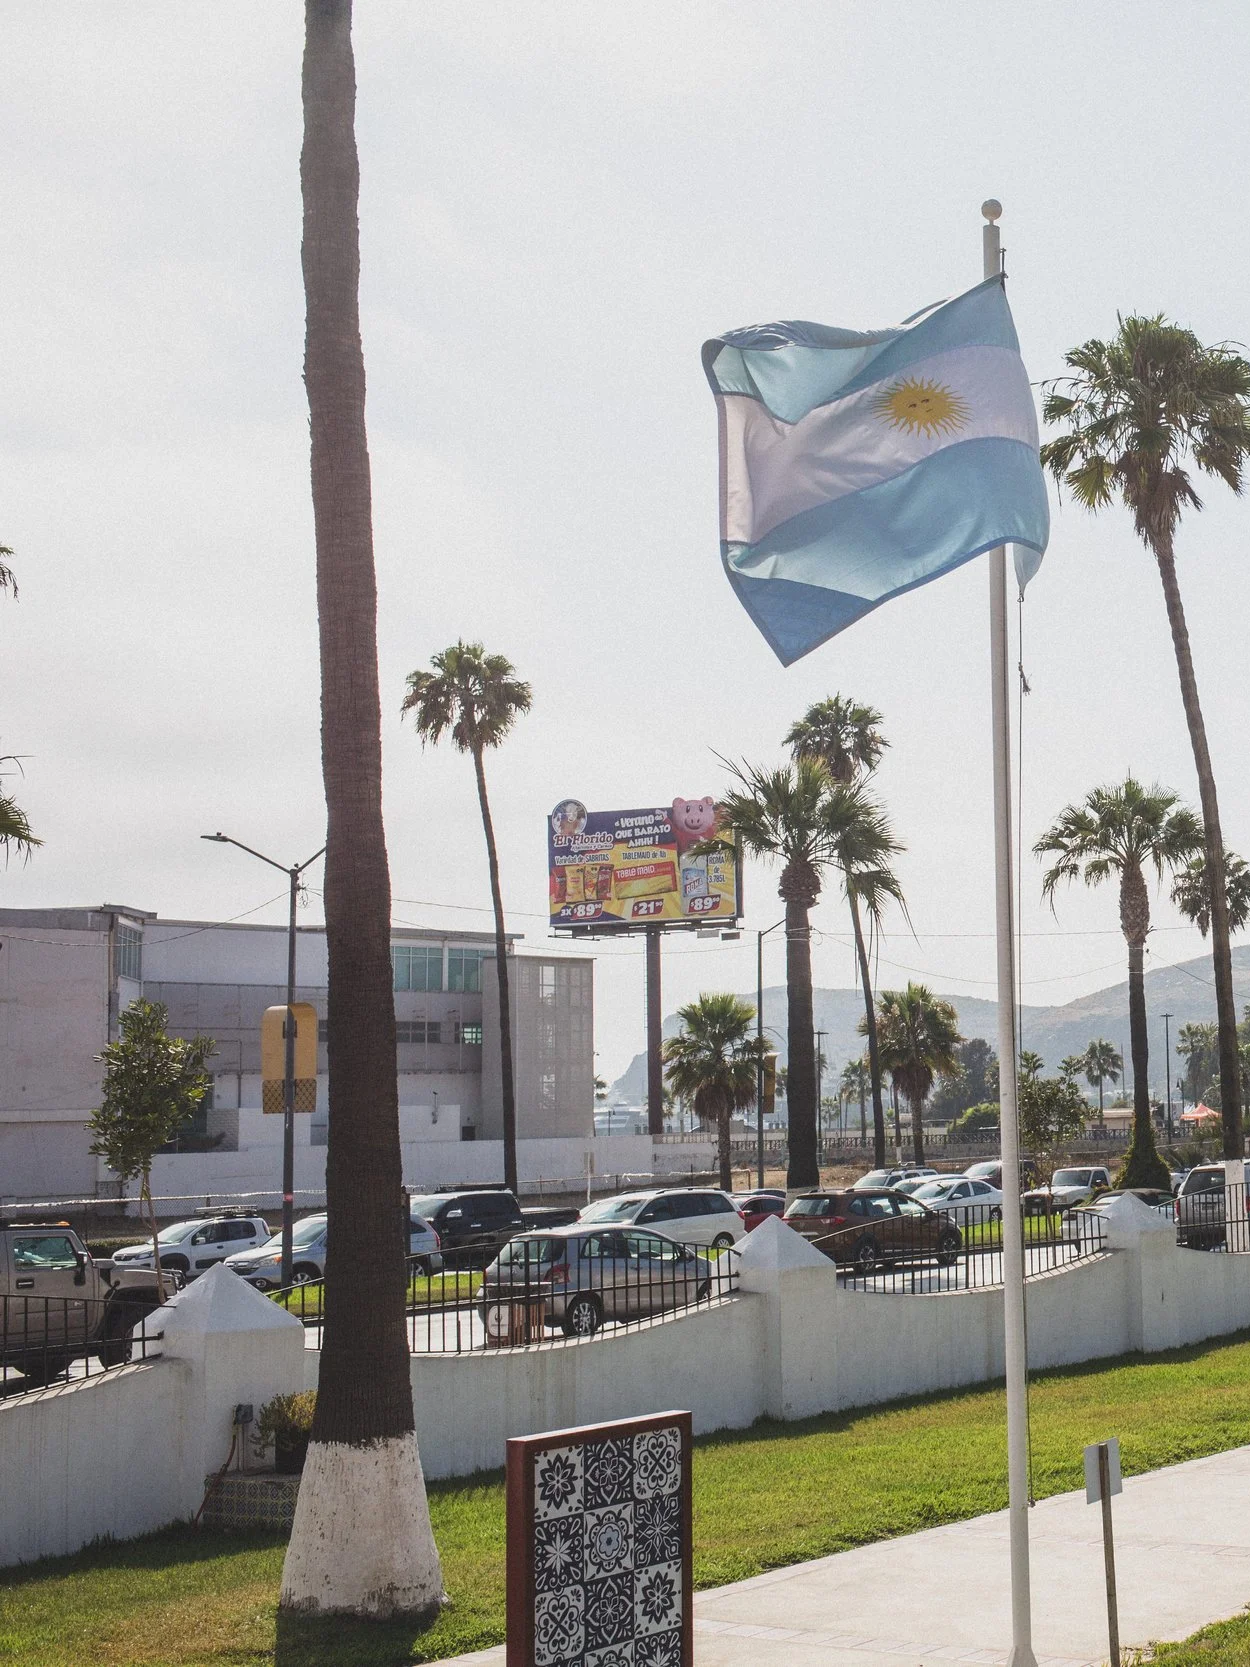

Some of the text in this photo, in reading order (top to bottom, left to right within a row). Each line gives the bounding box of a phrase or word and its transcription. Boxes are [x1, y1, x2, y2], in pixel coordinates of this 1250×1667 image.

[620, 815, 654, 827] Verano
[615, 824, 671, 839] QUE BARATO
[554, 832, 613, 847] El Florido
[585, 853, 609, 863] SABRITAS
[622, 851, 650, 860] TABLEMAID
